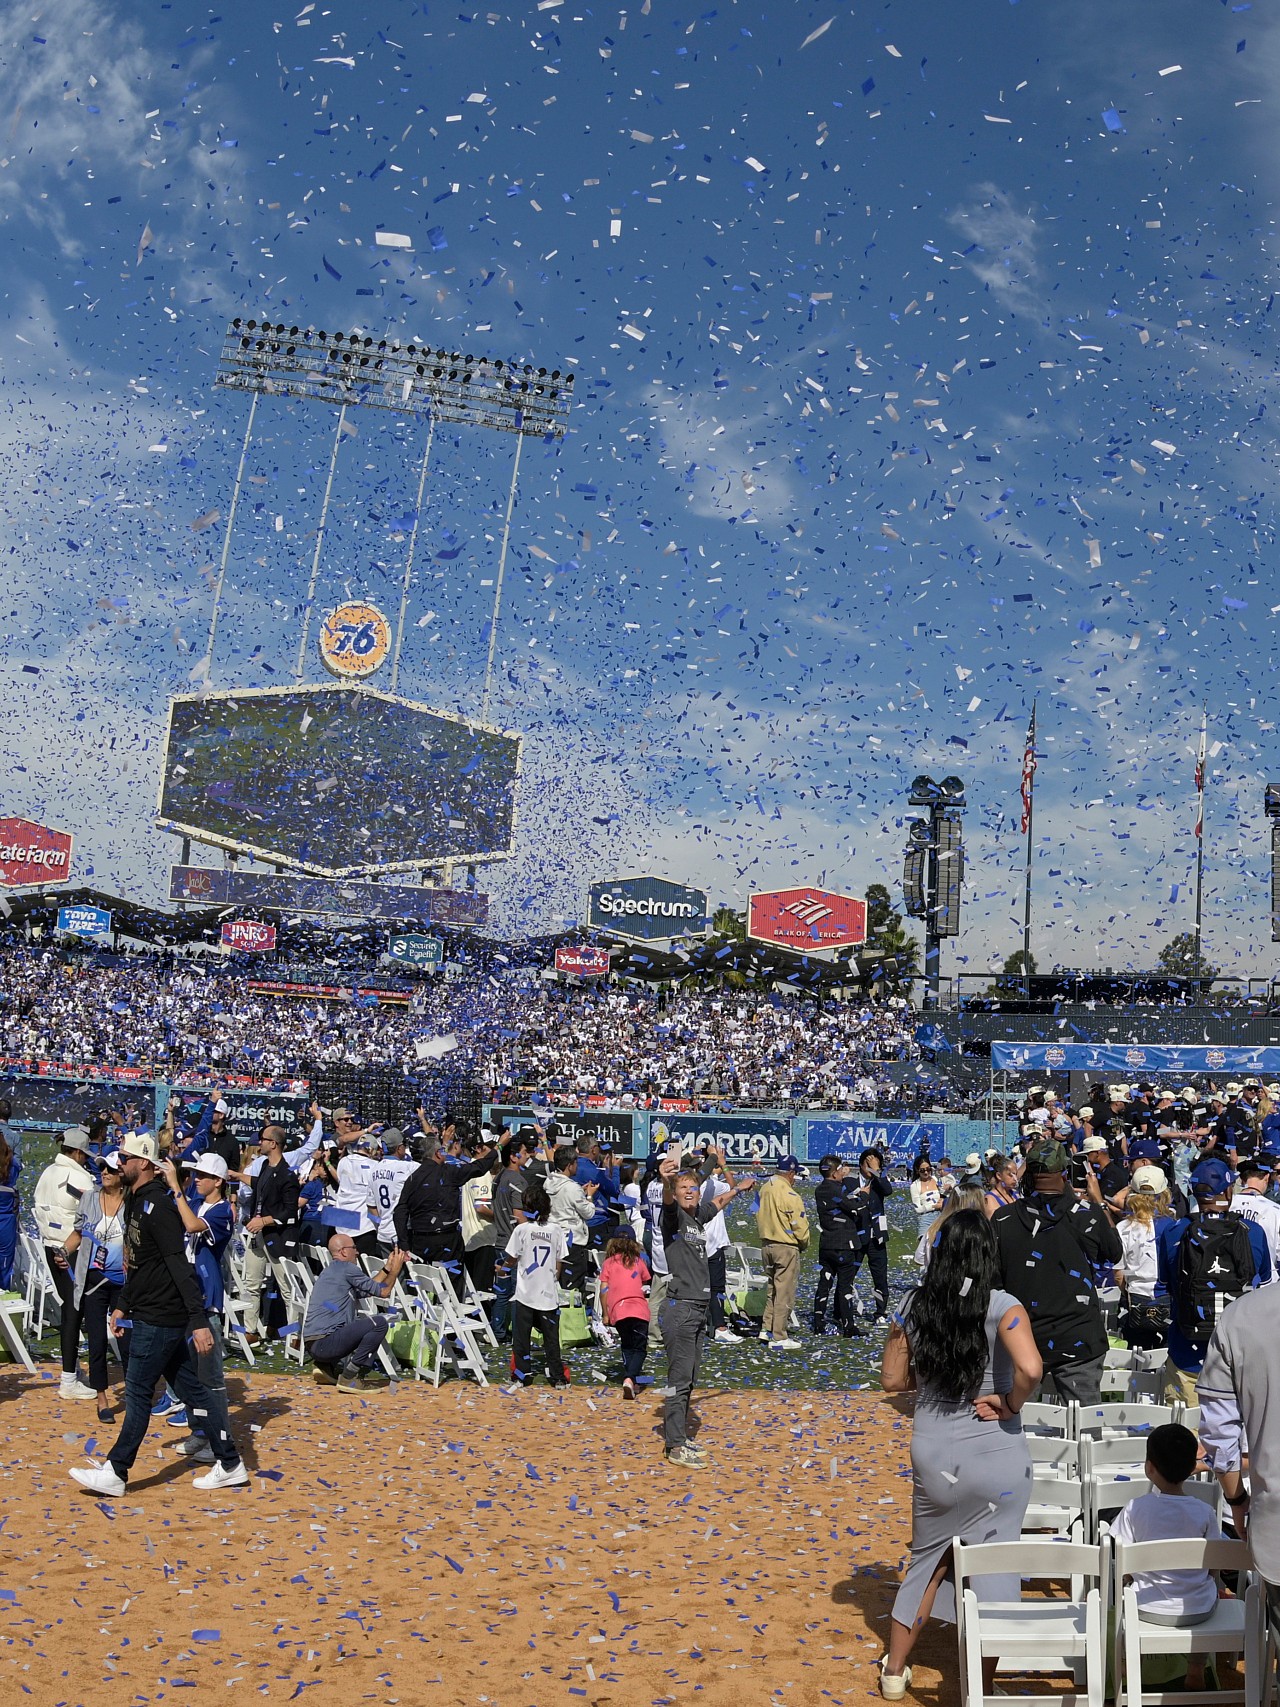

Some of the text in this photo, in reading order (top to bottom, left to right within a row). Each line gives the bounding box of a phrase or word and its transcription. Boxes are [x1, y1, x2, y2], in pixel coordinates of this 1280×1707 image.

[334, 621, 376, 656] 76
[0, 842, 67, 871] ateFarm
[599, 893, 692, 918] Spectrum
[230, 924, 268, 941] JINRO
[807, 931, 841, 939] AERICA
[409, 941, 438, 952] Security
[672, 1132, 788, 1158] MORTON
[835, 1126, 888, 1147] ANA
[835, 1151, 861, 1160] Inspira
[378, 1184, 391, 1209] 8
[532, 1245, 551, 1267] 17
